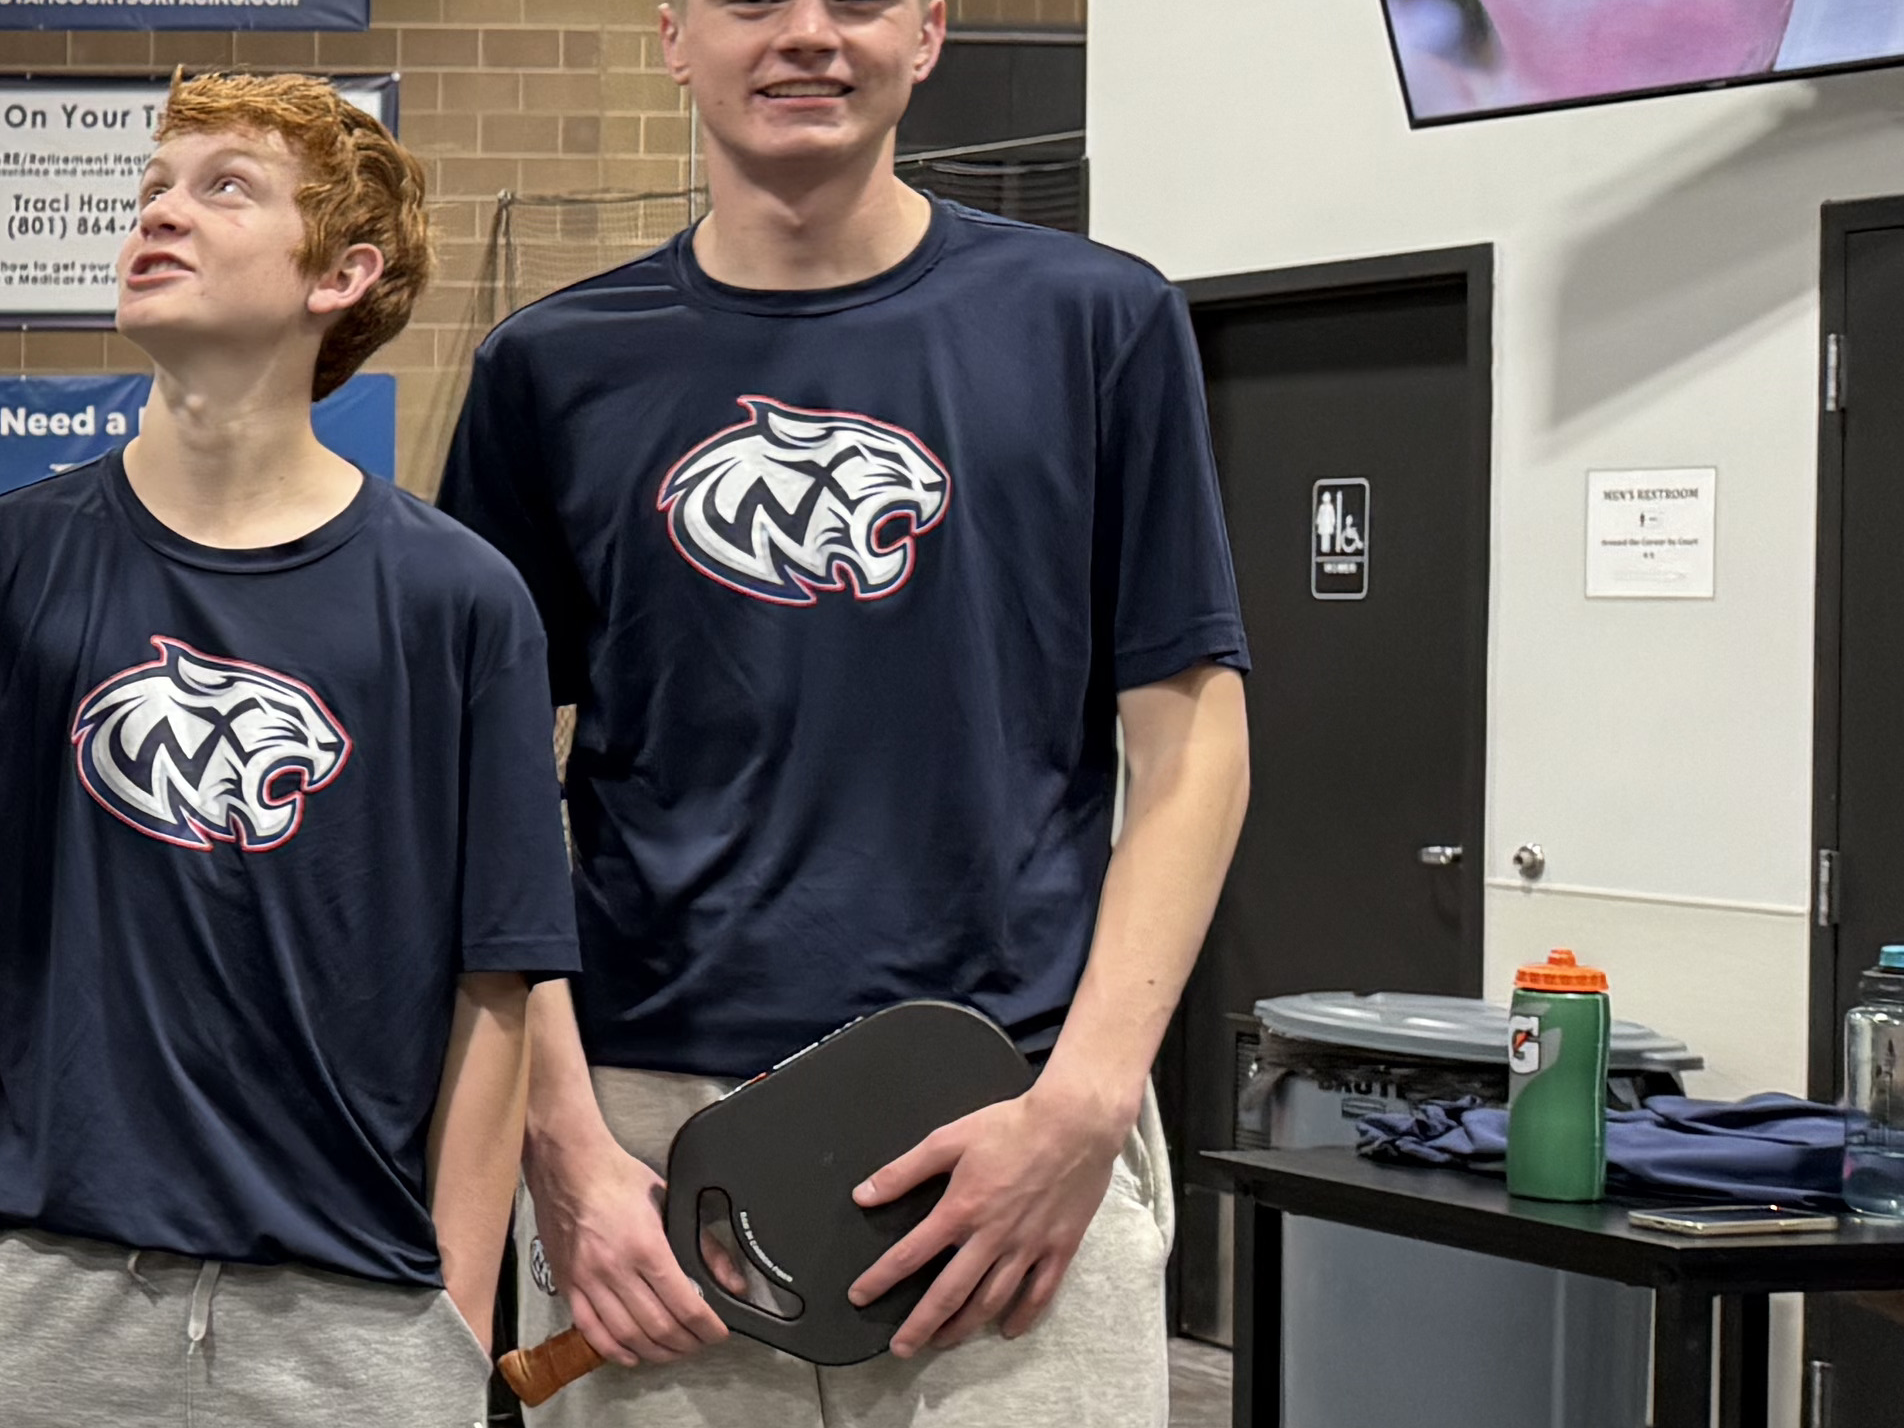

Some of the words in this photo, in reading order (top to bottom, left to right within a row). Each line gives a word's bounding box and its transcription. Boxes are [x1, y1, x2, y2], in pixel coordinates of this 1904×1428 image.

[4, 104, 47, 128] On
[61, 104, 130, 129] Your
[13, 193, 70, 213] Traci
[7, 215, 67, 240] (801)
[0, 260, 29, 272] how
[33, 260, 47, 272] to
[52, 261, 75, 273] get
[80, 261, 111, 273] your
[4, 275, 14, 285] a
[18, 274, 85, 285] Medicare
[0, 406, 95, 436] Need
[105, 411, 127, 435] a
